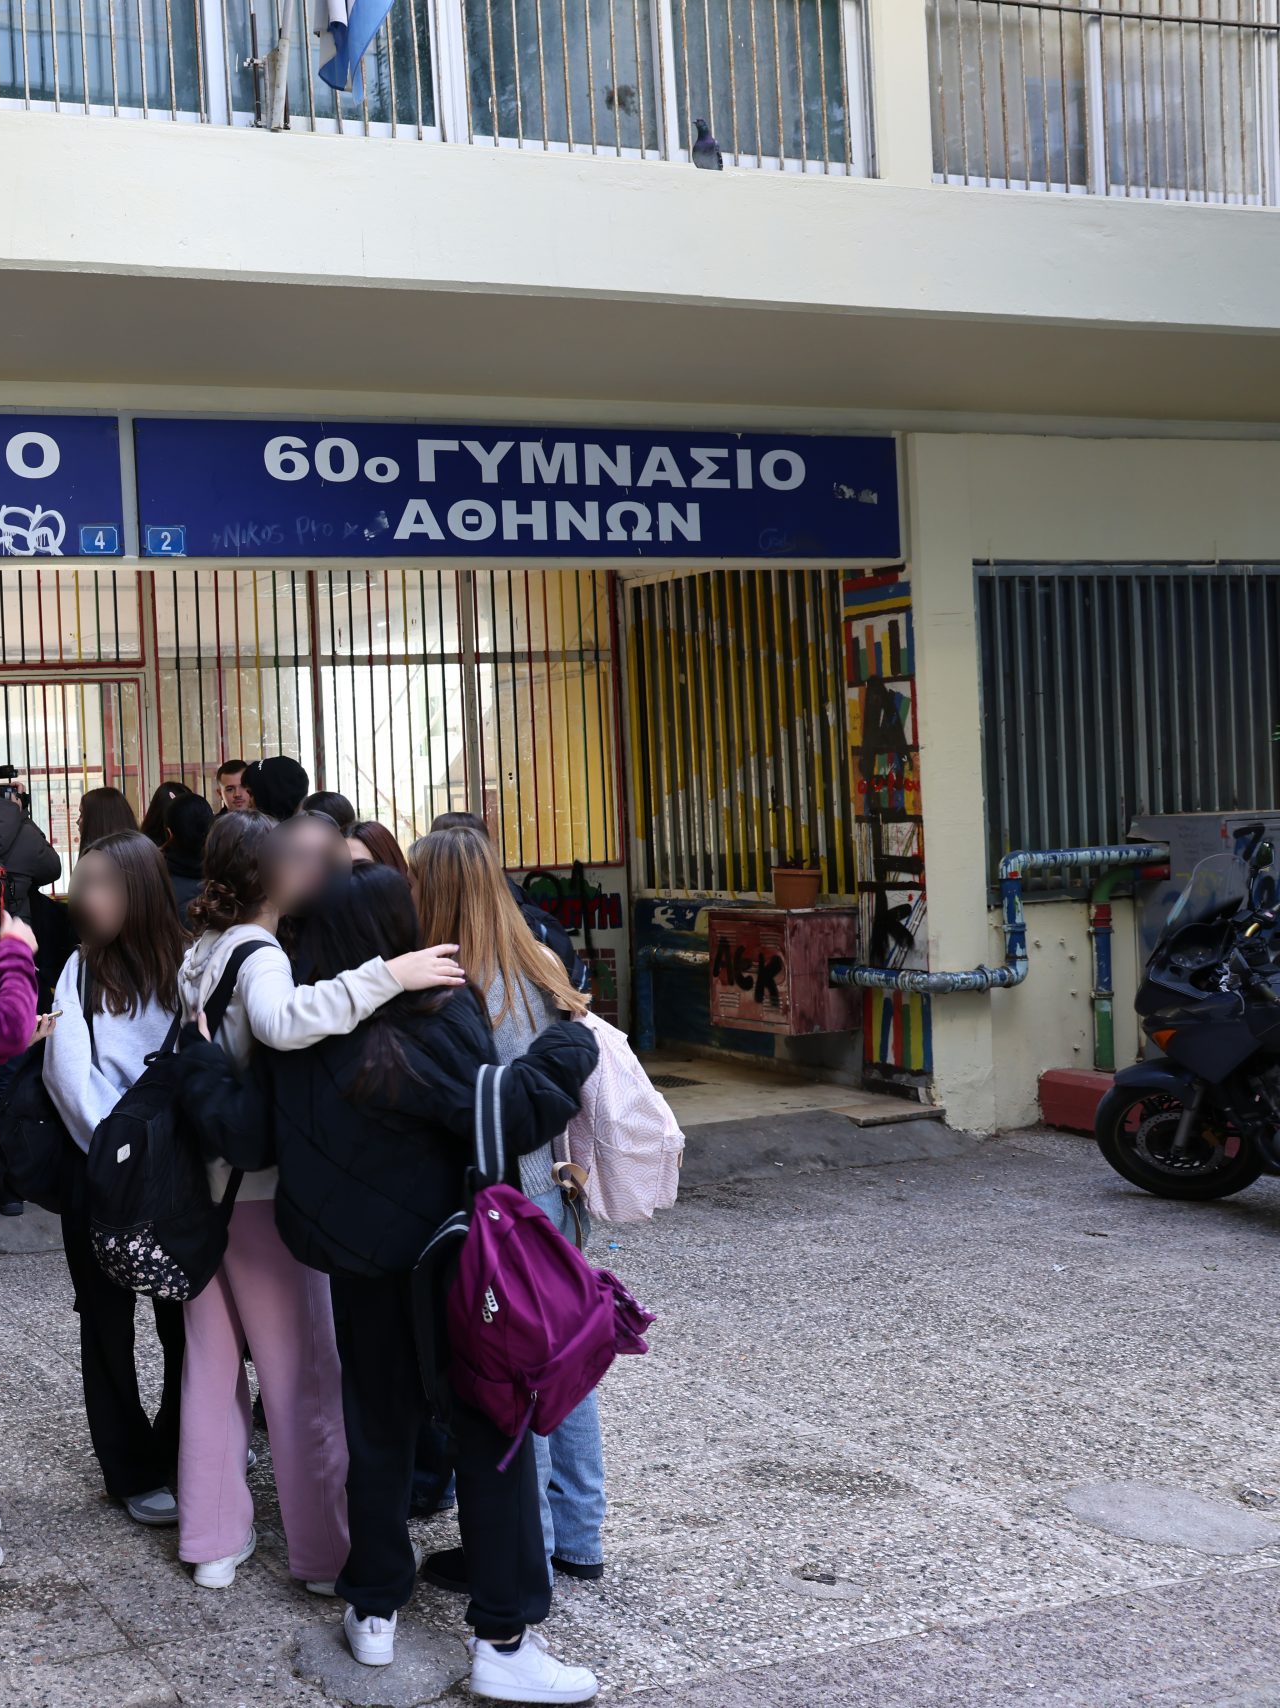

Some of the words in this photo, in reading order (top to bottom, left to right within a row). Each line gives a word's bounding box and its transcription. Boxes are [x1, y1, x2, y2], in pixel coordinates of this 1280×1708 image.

[263, 435, 400, 484] 60ο
[417, 438, 806, 491] ΓΥΜΝΑΣΙΟ
[393, 498, 701, 542] ΑΘΗΝΩΝ
[94, 531, 105, 550] 4
[160, 531, 172, 551] 2
